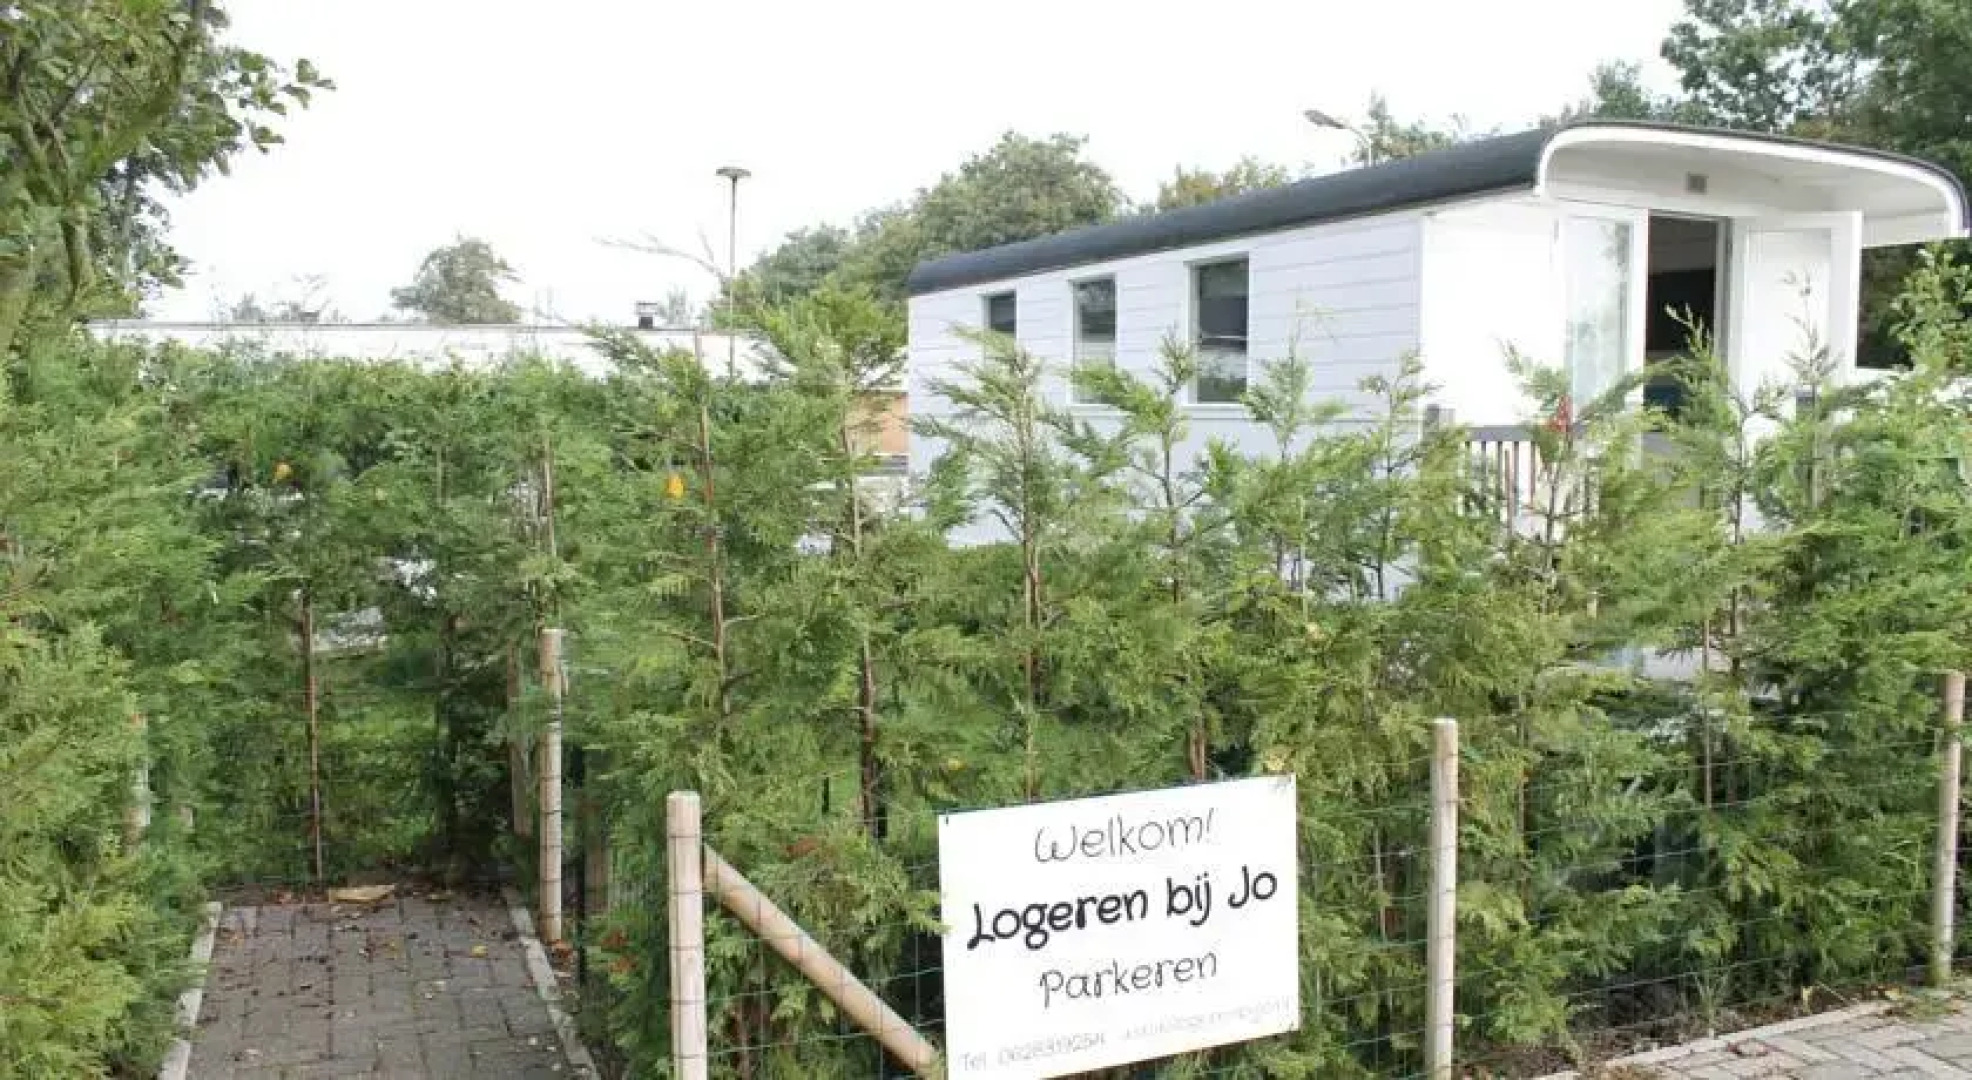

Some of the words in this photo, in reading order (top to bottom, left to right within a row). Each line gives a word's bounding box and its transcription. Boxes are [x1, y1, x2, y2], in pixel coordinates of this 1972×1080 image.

[1034, 807, 1214, 862] Welkom!
[967, 890, 1149, 950] Logeren
[1165, 872, 1212, 927] bij
[1228, 865, 1278, 909] Jo
